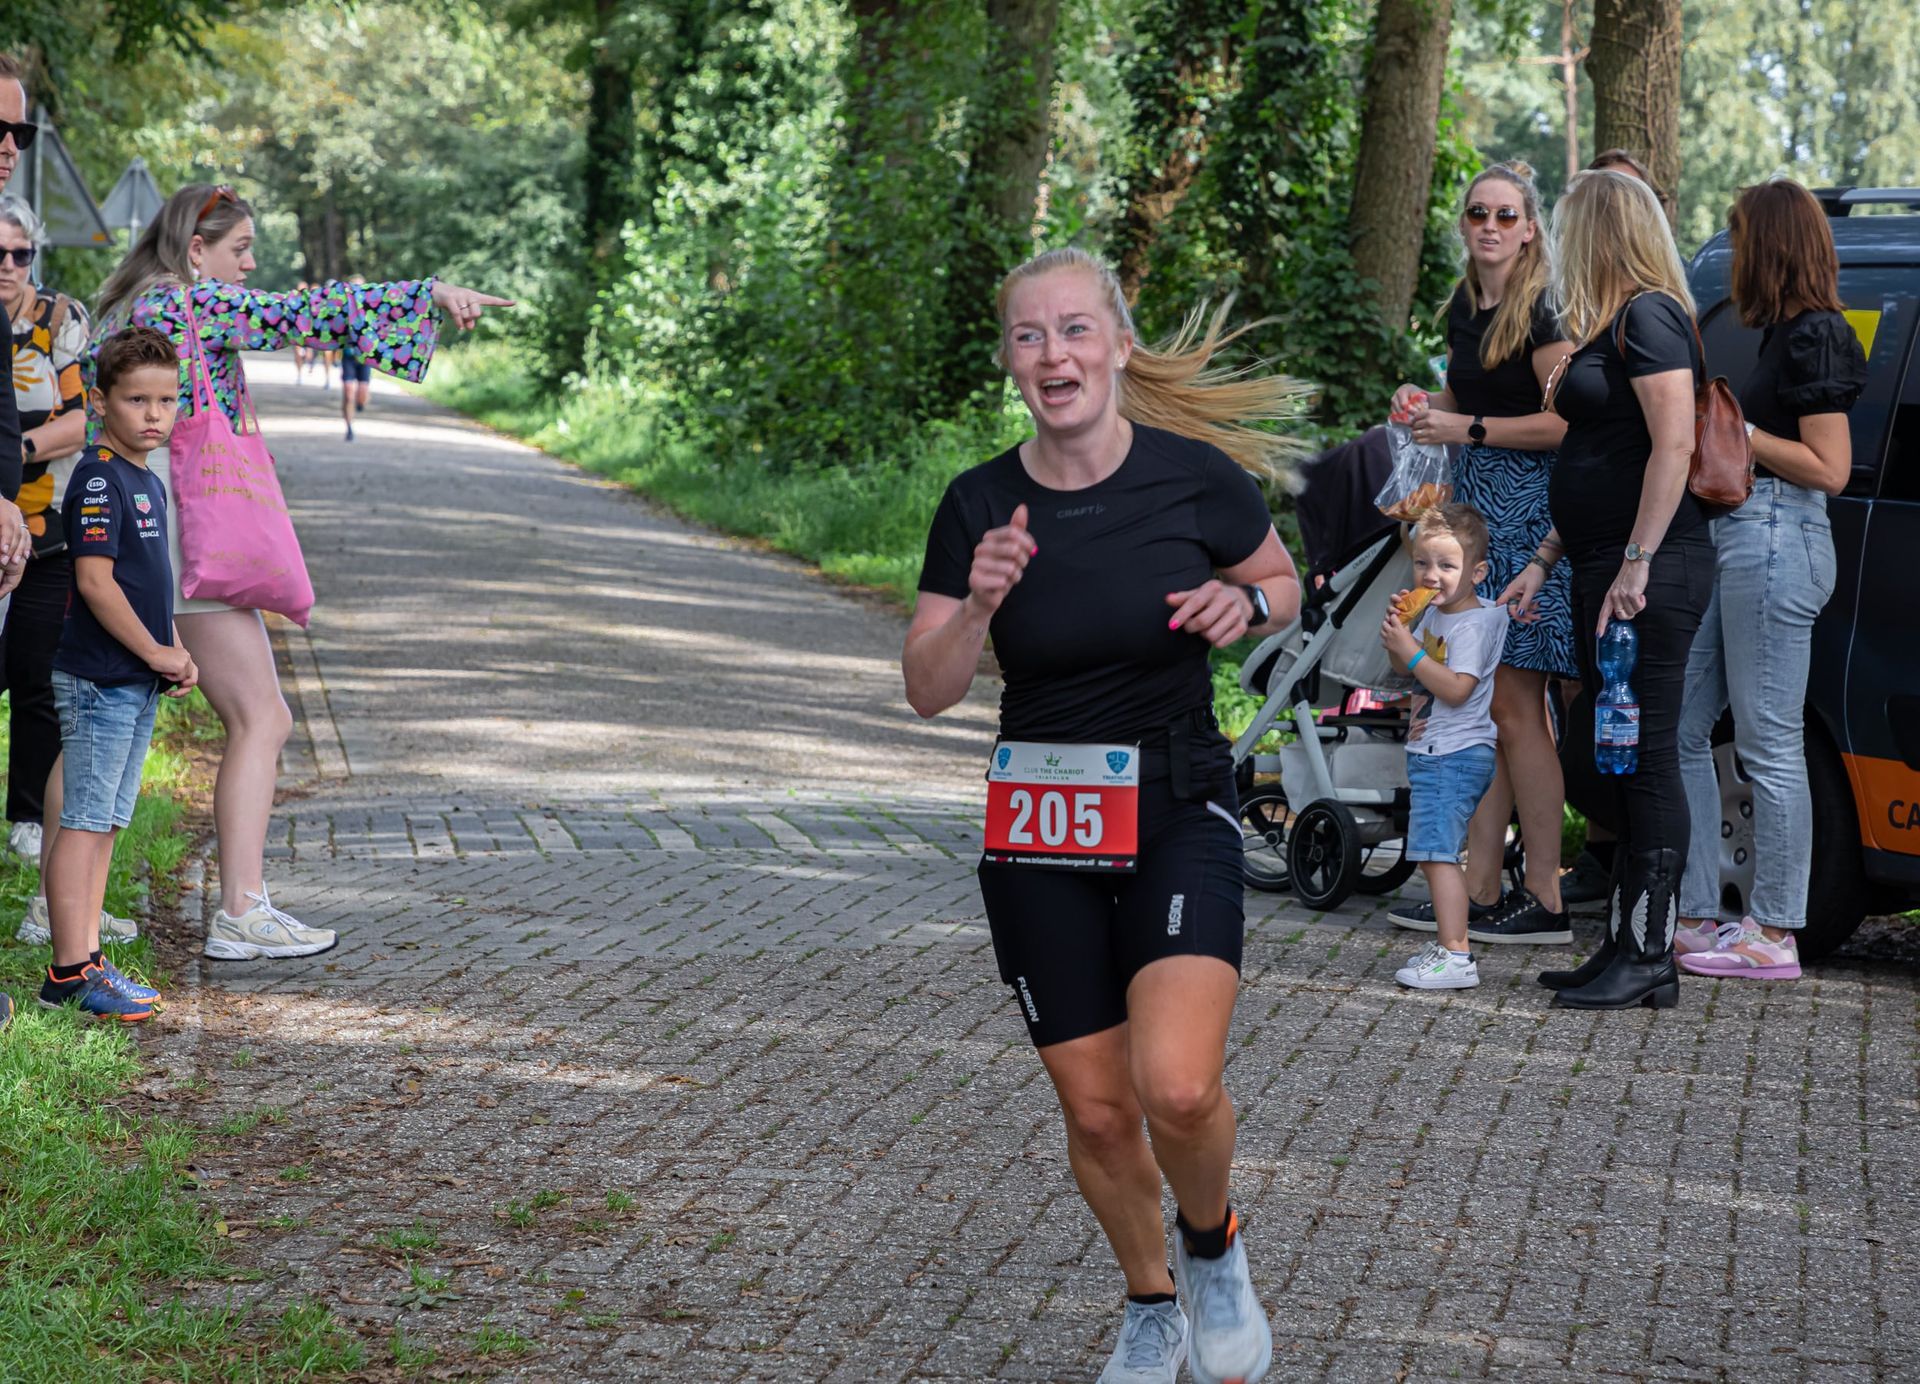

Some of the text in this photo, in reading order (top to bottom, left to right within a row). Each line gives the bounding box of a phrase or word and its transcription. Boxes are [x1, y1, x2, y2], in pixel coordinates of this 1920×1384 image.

[83, 496, 105, 505] Claro
[1056, 505, 1095, 519] CRAFT
[1008, 789, 1103, 848] 205
[1017, 976, 1040, 1022] FUSION
